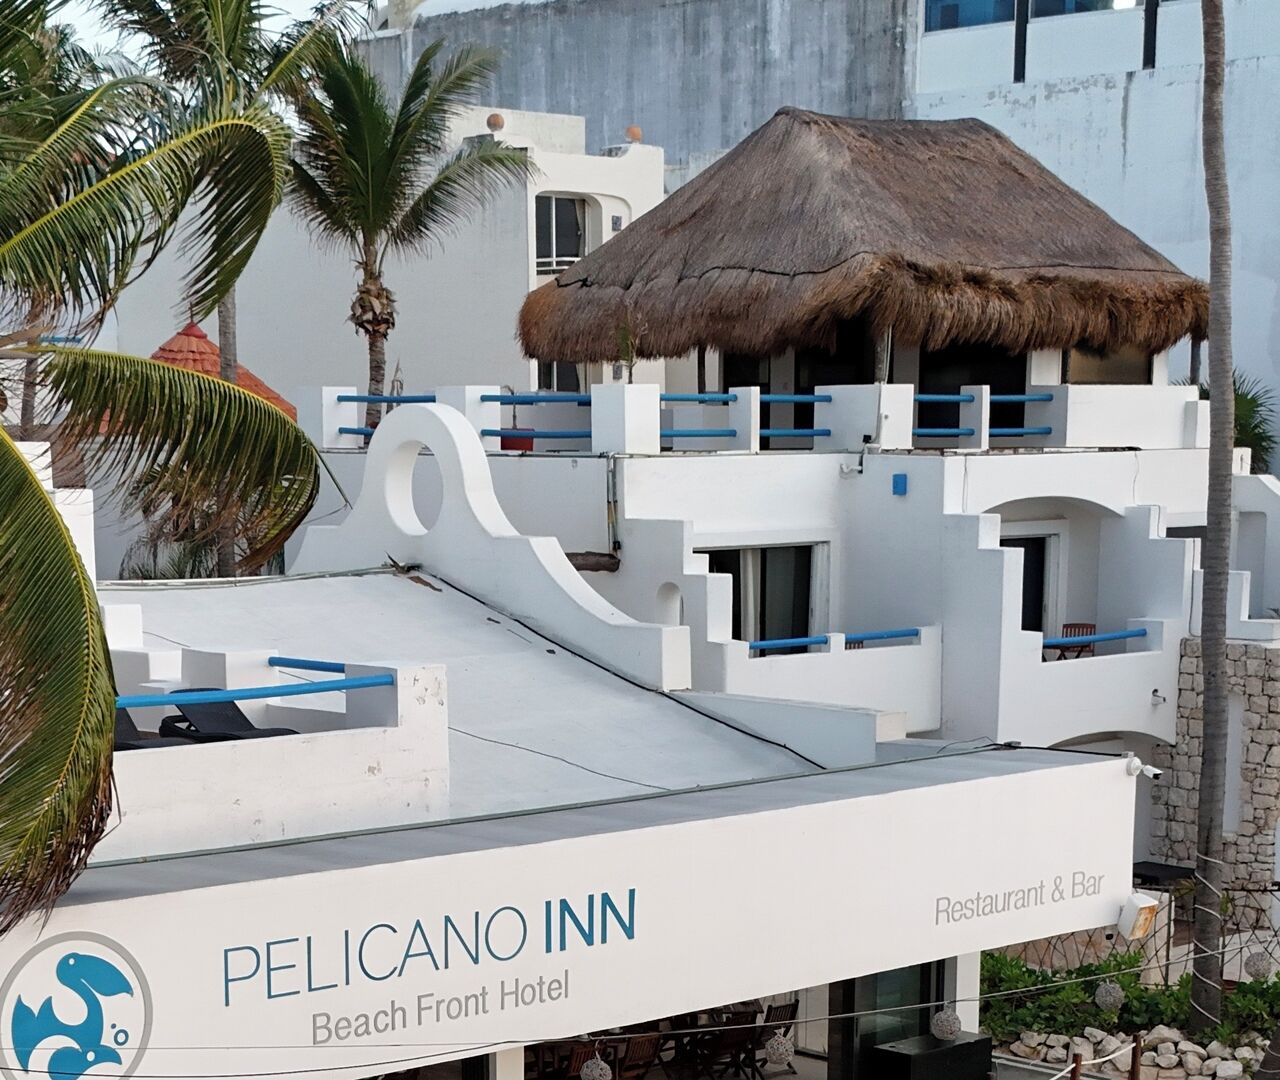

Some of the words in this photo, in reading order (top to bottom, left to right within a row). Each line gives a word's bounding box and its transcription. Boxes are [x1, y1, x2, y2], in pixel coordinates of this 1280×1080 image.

[935, 879, 1046, 926] Restaurant
[1051, 875, 1065, 903] &
[1071, 870, 1106, 899] Bar
[223, 905, 527, 1007] PELICANO
[545, 888, 636, 953] INN
[312, 1007, 407, 1045] Beach
[417, 988, 489, 1026] Front
[500, 970, 569, 1011] Hotel
